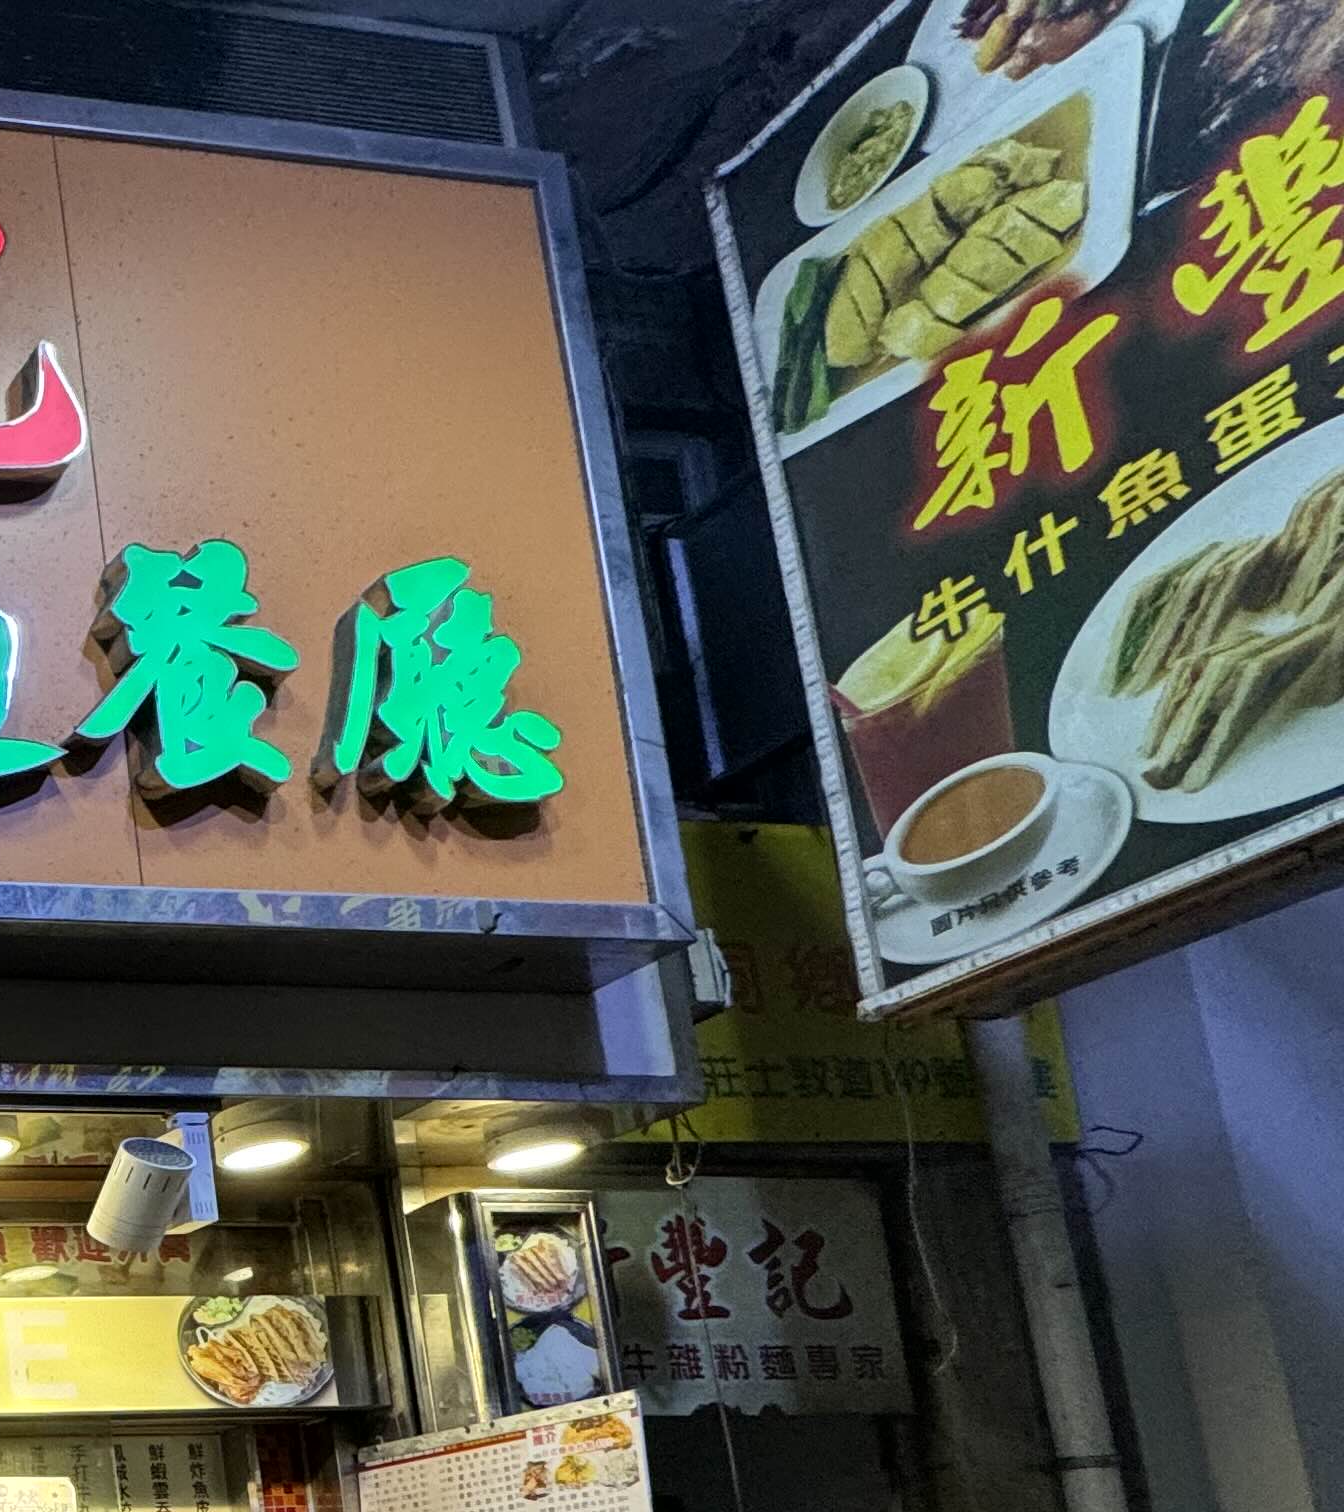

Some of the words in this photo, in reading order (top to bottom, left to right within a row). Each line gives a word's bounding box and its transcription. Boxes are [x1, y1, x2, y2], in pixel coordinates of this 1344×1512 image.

[913, 343, 1344, 645] 牛什魚蛋
[602, 1214, 853, 1320] 豐記
